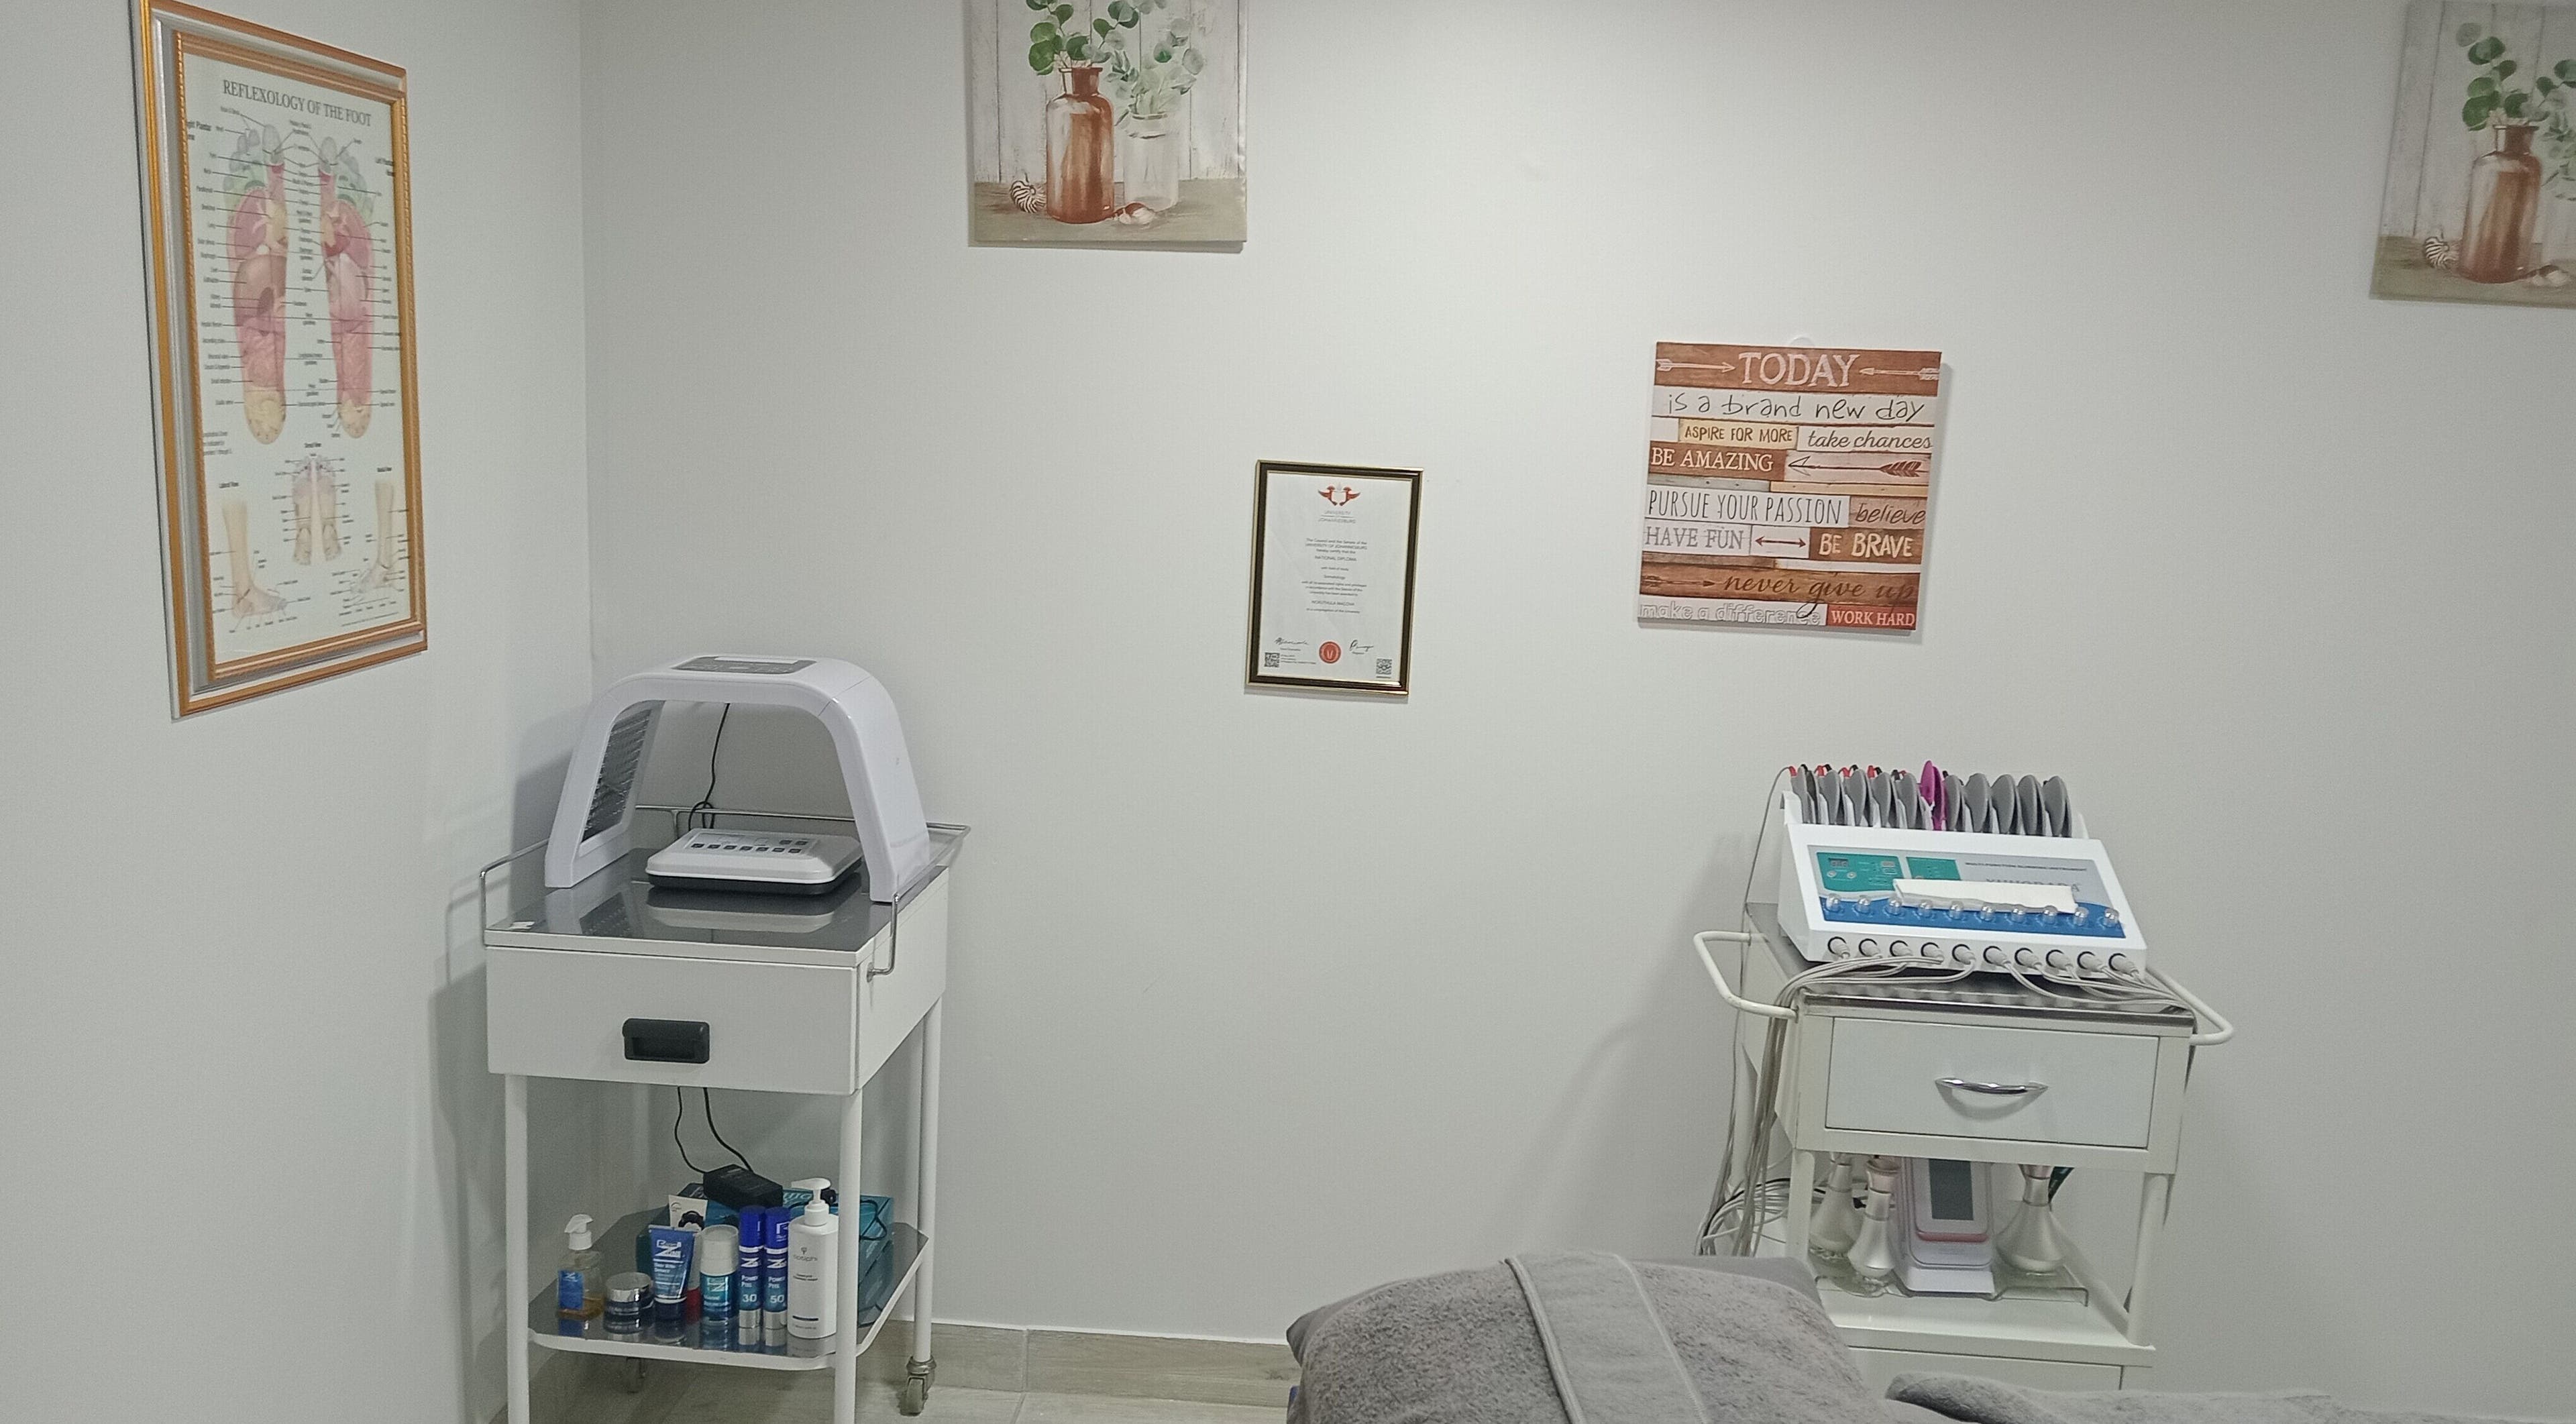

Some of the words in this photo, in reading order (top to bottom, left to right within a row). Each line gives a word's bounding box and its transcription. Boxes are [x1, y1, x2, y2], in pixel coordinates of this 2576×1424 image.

[223, 79, 305, 112] REFLEXOLOGY
[307, 99, 323, 115] OF
[323, 103, 343, 121] THE
[345, 109, 372, 127] FOOT
[1738, 351, 1860, 387] TODAY
[1668, 392, 1688, 415] is
[1698, 396, 1711, 413] a
[1721, 394, 1802, 418] brand
[1815, 399, 1866, 420] new
[1875, 396, 1925, 423] day
[1684, 425, 1725, 440] ASPIRE
[1731, 427, 1754, 441] FOR
[1759, 428, 1792, 443] MORE
[1807, 431, 1851, 448] take
[1852, 431, 1933, 449] chances
[1650, 447, 1675, 468] BE
[1680, 450, 1774, 472] AMAZING
[1648, 489, 1709, 519] PURSUE
[1717, 494, 1758, 521] YOUR
[1765, 496, 1842, 525] PASSION
[1855, 502, 1927, 524] believe
[1645, 525, 1698, 548] HAVE
[1705, 528, 1743, 549] FUN
[1819, 533, 1842, 556] BE
[1851, 533, 1914, 559] BRAVE
[1723, 573, 1801, 594] never
[1796, 578, 1866, 618] give
[1876, 582, 1916, 609] up
[1639, 602, 1693, 620] make
[1697, 606, 1710, 620] a
[1715, 603, 1821, 626] difference
[1831, 609, 1874, 624] WORK
[1876, 611, 1916, 627] HARD
[742, 1293, 757, 1303] 30
[769, 1295, 785, 1304] 50
